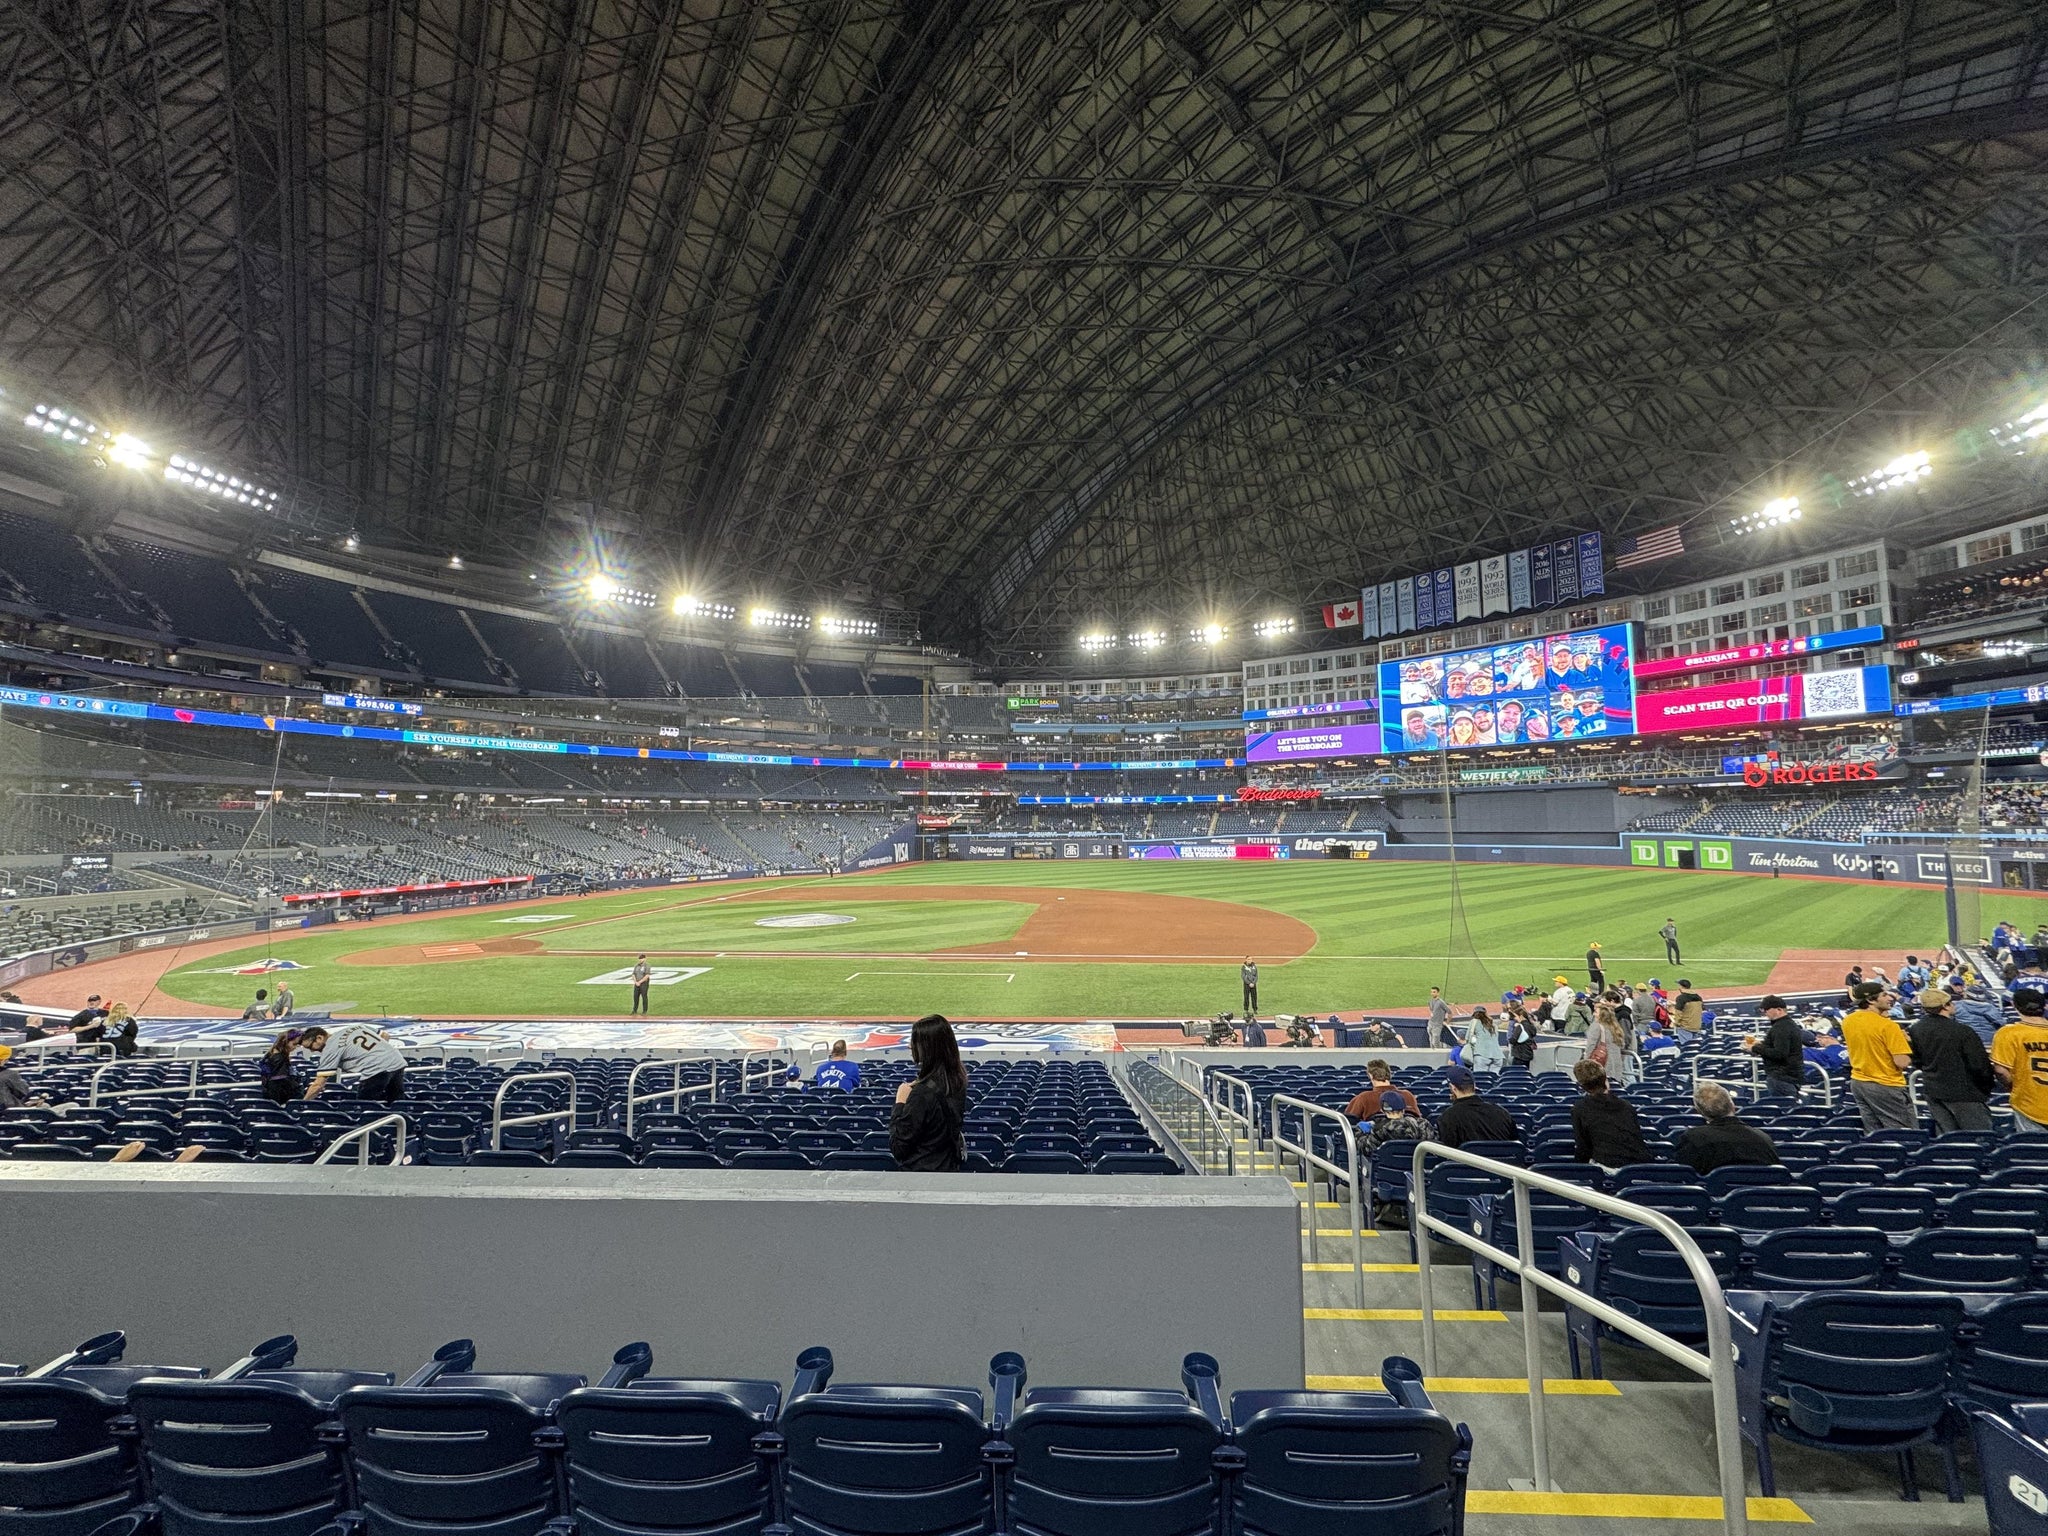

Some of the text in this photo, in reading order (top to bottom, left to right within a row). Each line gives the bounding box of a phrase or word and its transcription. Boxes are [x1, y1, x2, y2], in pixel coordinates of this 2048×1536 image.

[1582, 549, 1599, 557] 2025
[1558, 568, 1575, 576] 2020
[1458, 577, 1477, 587] 1992
[1559, 577, 1575, 585] 2022
[1685, 652, 1739, 666] @BLUEJAYS
[1664, 694, 1789, 715] SCAN THE QR CODE
[413, 733, 430, 741] SEE
[431, 734, 475, 744] YOURSELF
[491, 739, 508, 747] THE
[509, 741, 559, 750] VIDEOBOARD
[1293, 742, 1343, 751] VIDEOBOARD
[1977, 748, 2018, 757] CANADA
[1461, 771, 1508, 781] WESTJET
[1773, 761, 1878, 784] ROGERS
[1236, 787, 1322, 801] Budweiser
[893, 843, 909, 862] VISA
[1634, 845, 1655, 860] TD
[1703, 846, 1728, 864] TD
[1748, 852, 1819, 868] Tim Hortons
[1925, 862, 1984, 873] TH KEG
[353, 1031, 381, 1051] 21
[2018, 1483, 2039, 1506] 21
